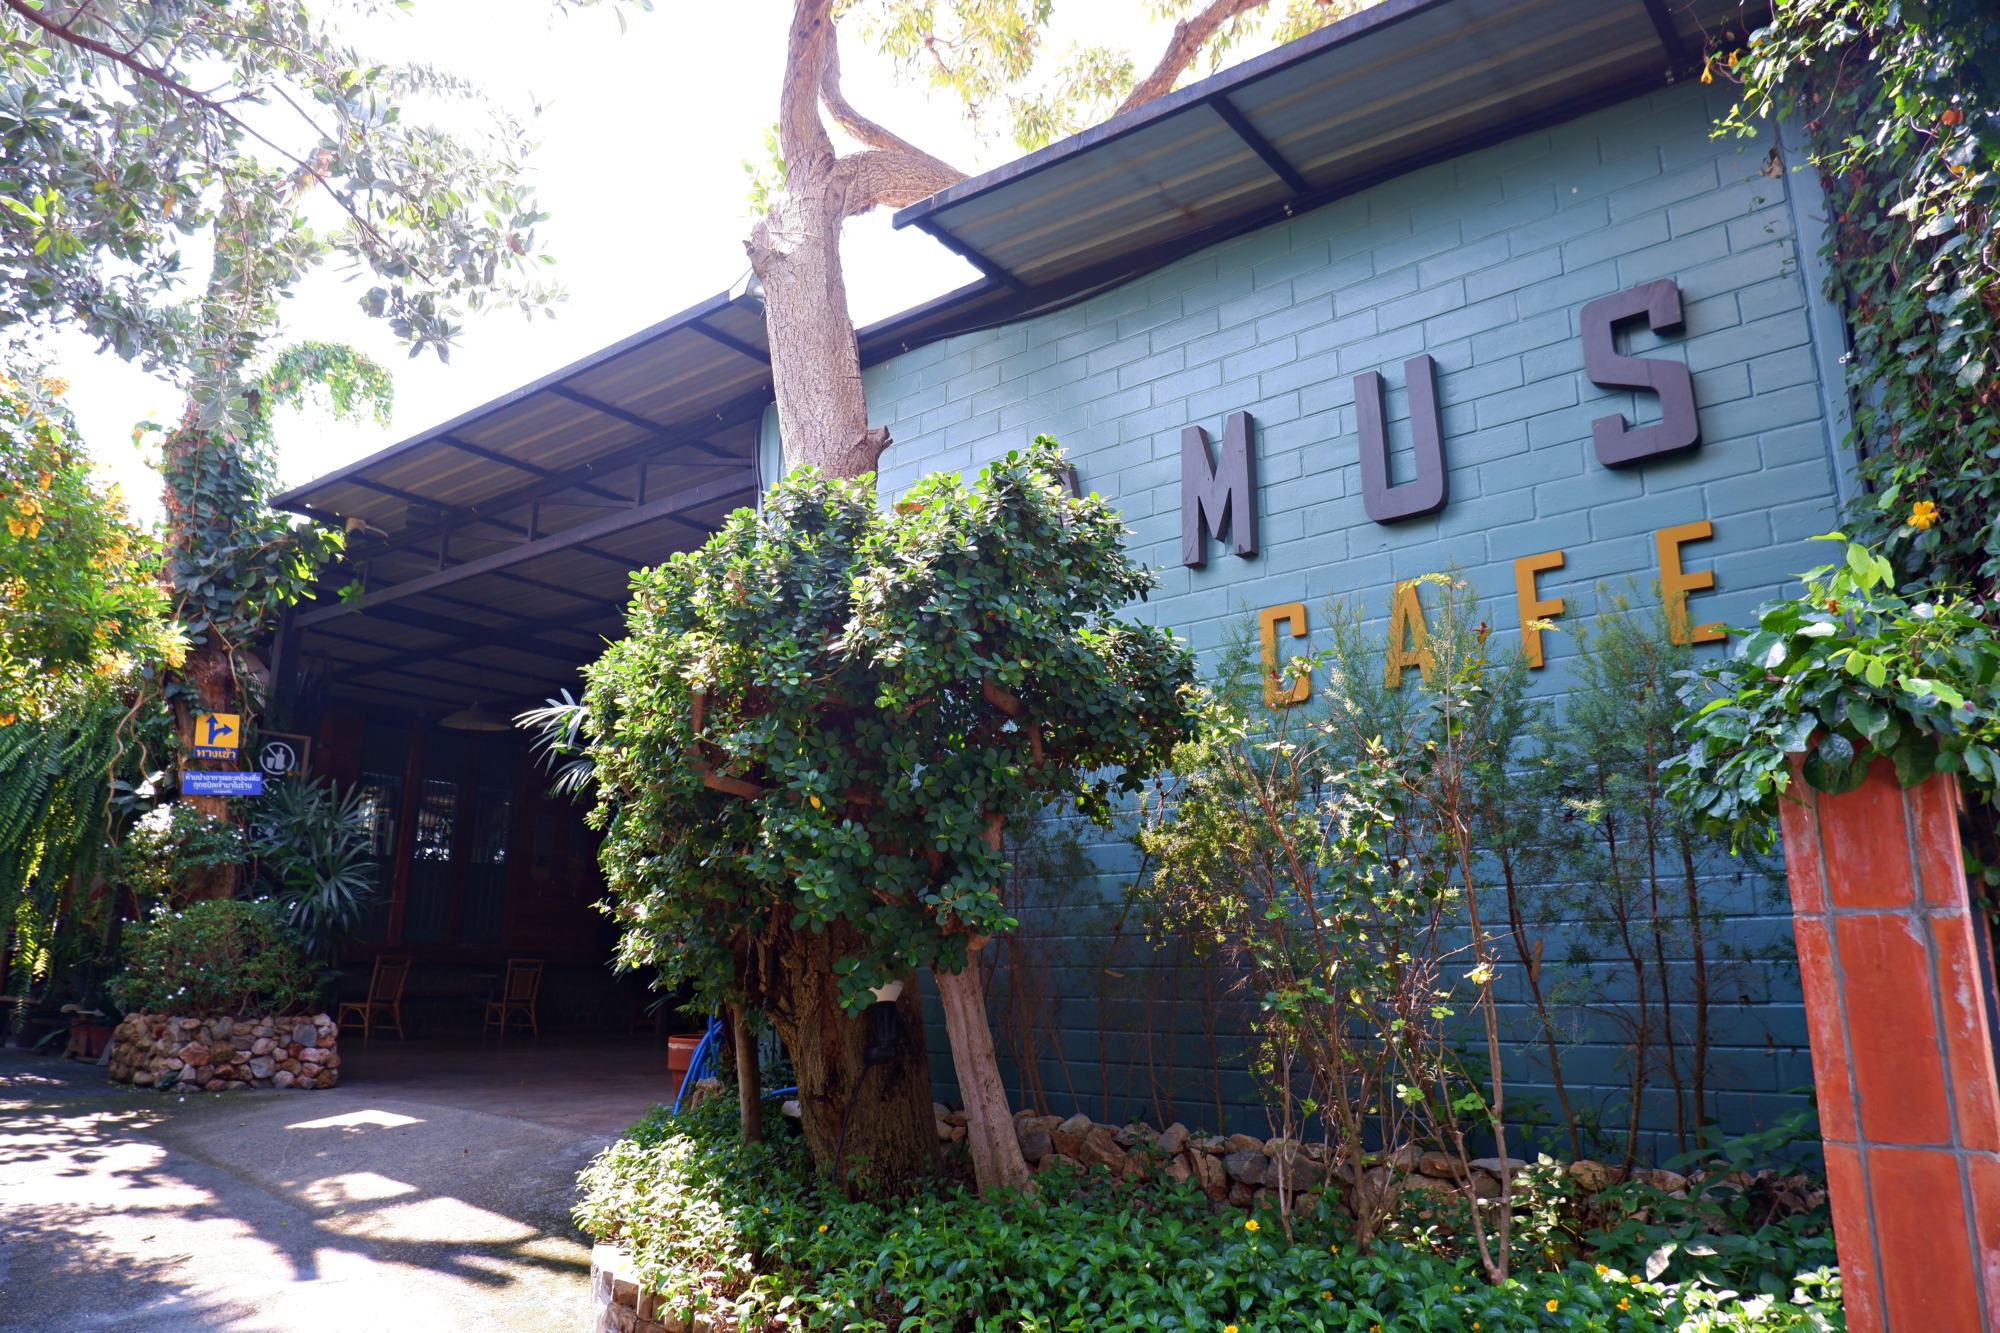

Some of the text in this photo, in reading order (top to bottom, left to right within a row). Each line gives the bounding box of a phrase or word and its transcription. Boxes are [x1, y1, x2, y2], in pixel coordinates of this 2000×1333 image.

[1054, 279, 1701, 567] MUS
[1259, 520, 1727, 711] CAFE
[196, 748, 236, 758] ทางเข้า
